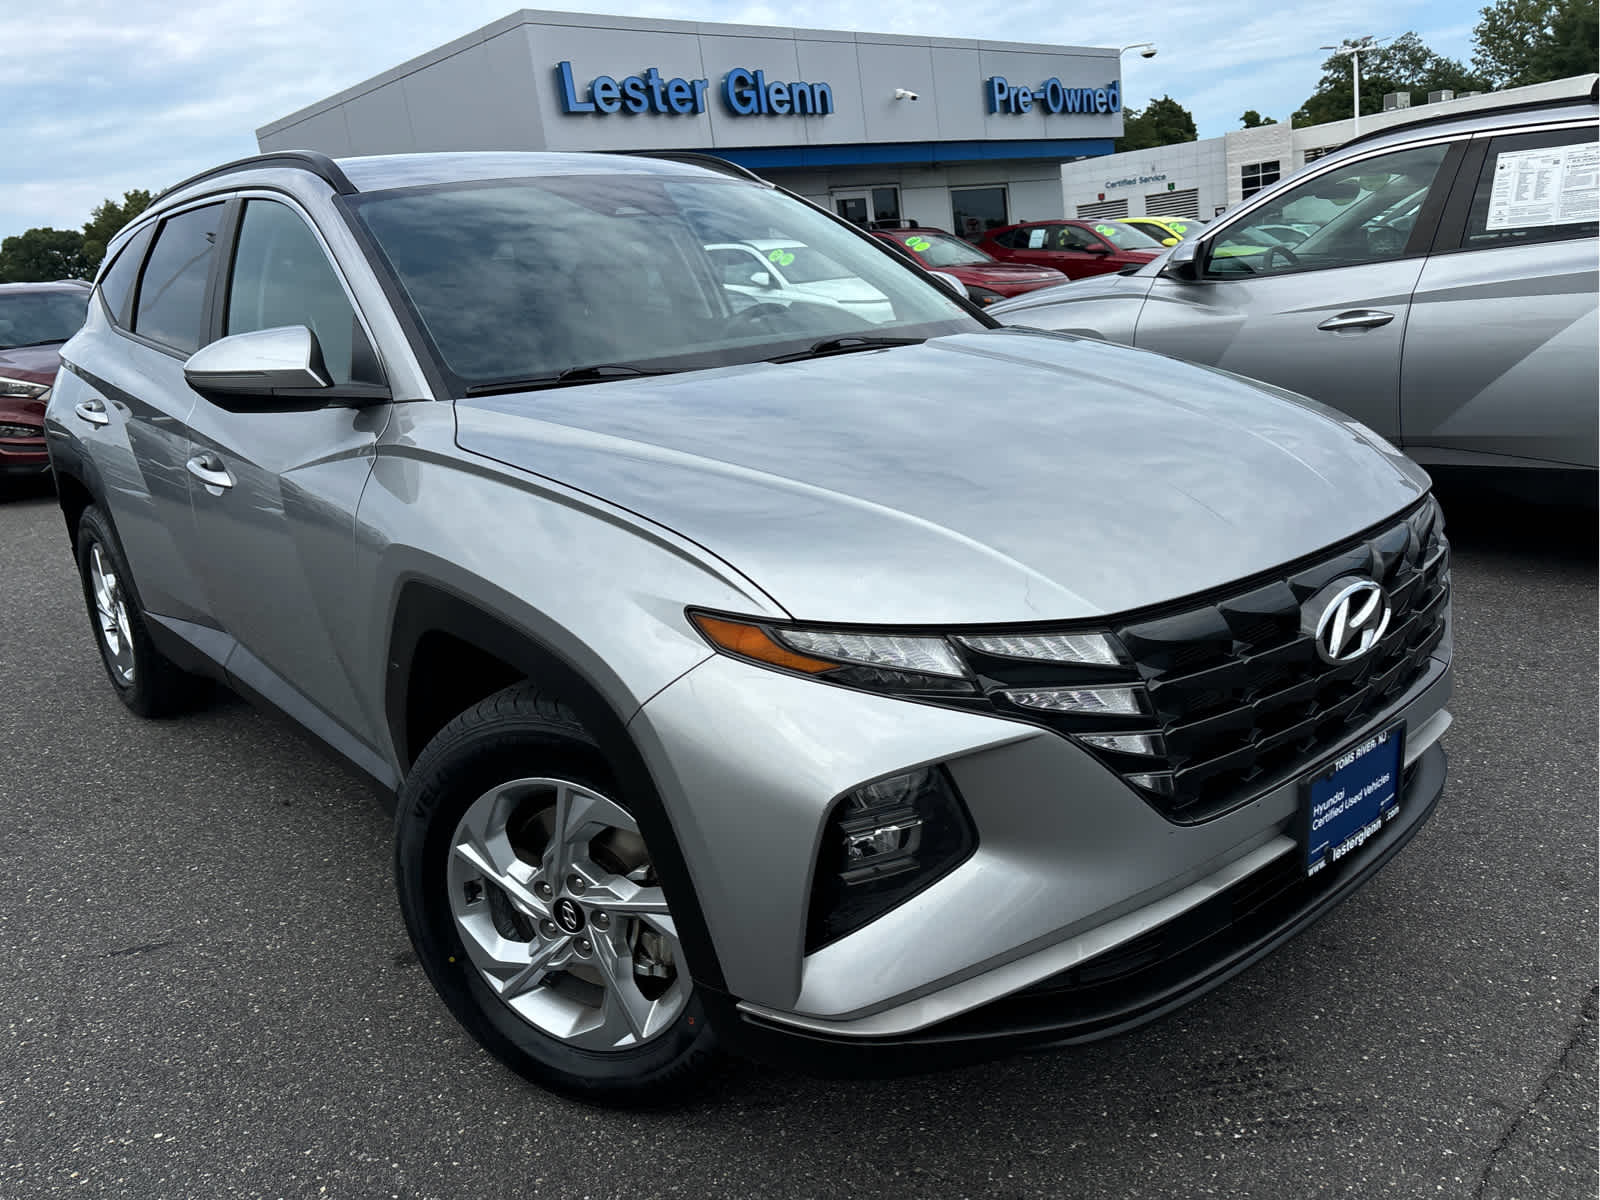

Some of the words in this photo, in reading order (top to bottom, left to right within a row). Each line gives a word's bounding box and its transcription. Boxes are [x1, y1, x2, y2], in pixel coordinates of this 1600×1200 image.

[554, 60, 709, 114] Lester
[721, 67, 834, 116] Glenn
[986, 76, 1121, 114] Pre-Owned
[1105, 178, 1136, 188] Certified
[1139, 174, 1166, 184] Service
[1335, 752, 1355, 772] TOMS
[1312, 801, 1344, 831] Certified
[1344, 788, 1363, 809] Used
[1363, 772, 1390, 797] Vehicles
[1313, 787, 1345, 817] Hyundai
[1332, 819, 1382, 862] lesterglenn
